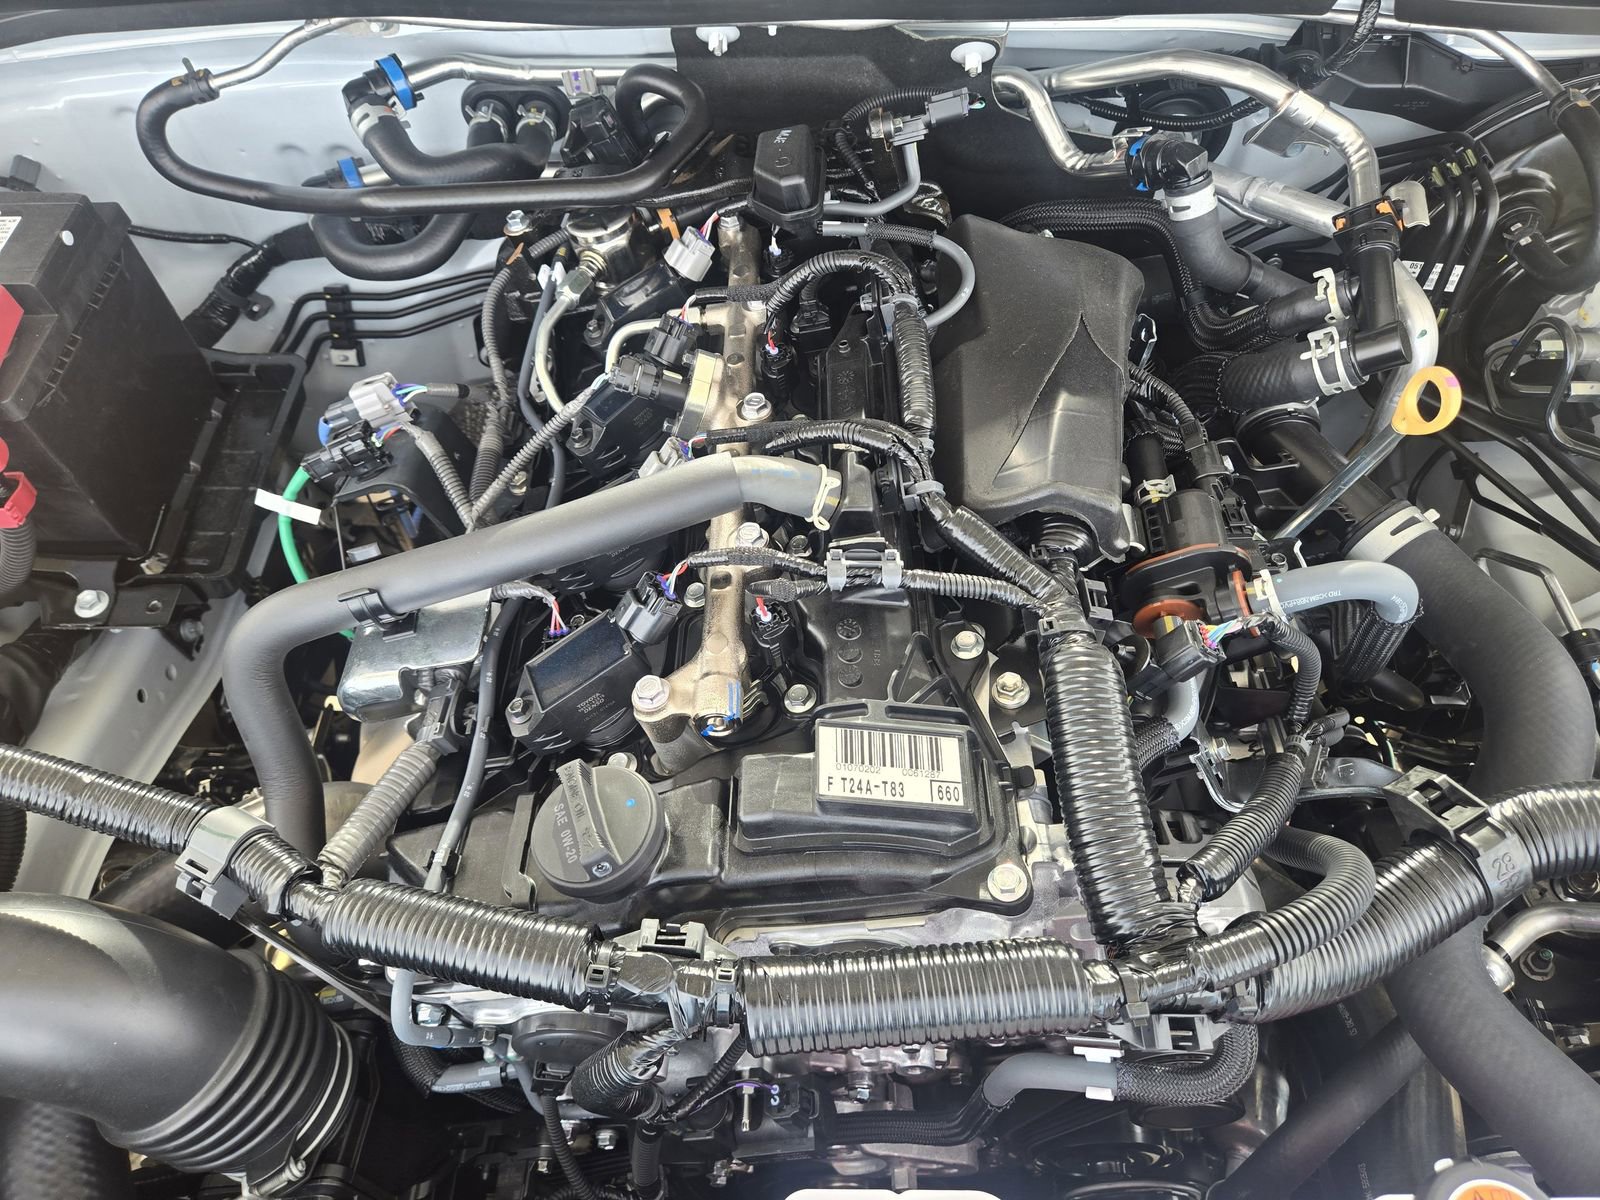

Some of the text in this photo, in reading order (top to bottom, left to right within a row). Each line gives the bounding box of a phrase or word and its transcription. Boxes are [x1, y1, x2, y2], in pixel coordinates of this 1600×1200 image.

[576, 693, 601, 709] TOYOTA
[583, 698, 605, 714] DENSO
[562, 765, 587, 822] ENGINE OIL
[827, 776, 960, 802] F T24A-T83 660
[553, 803, 578, 864] SAE 0W-20
[1491, 852, 1516, 881] 28
